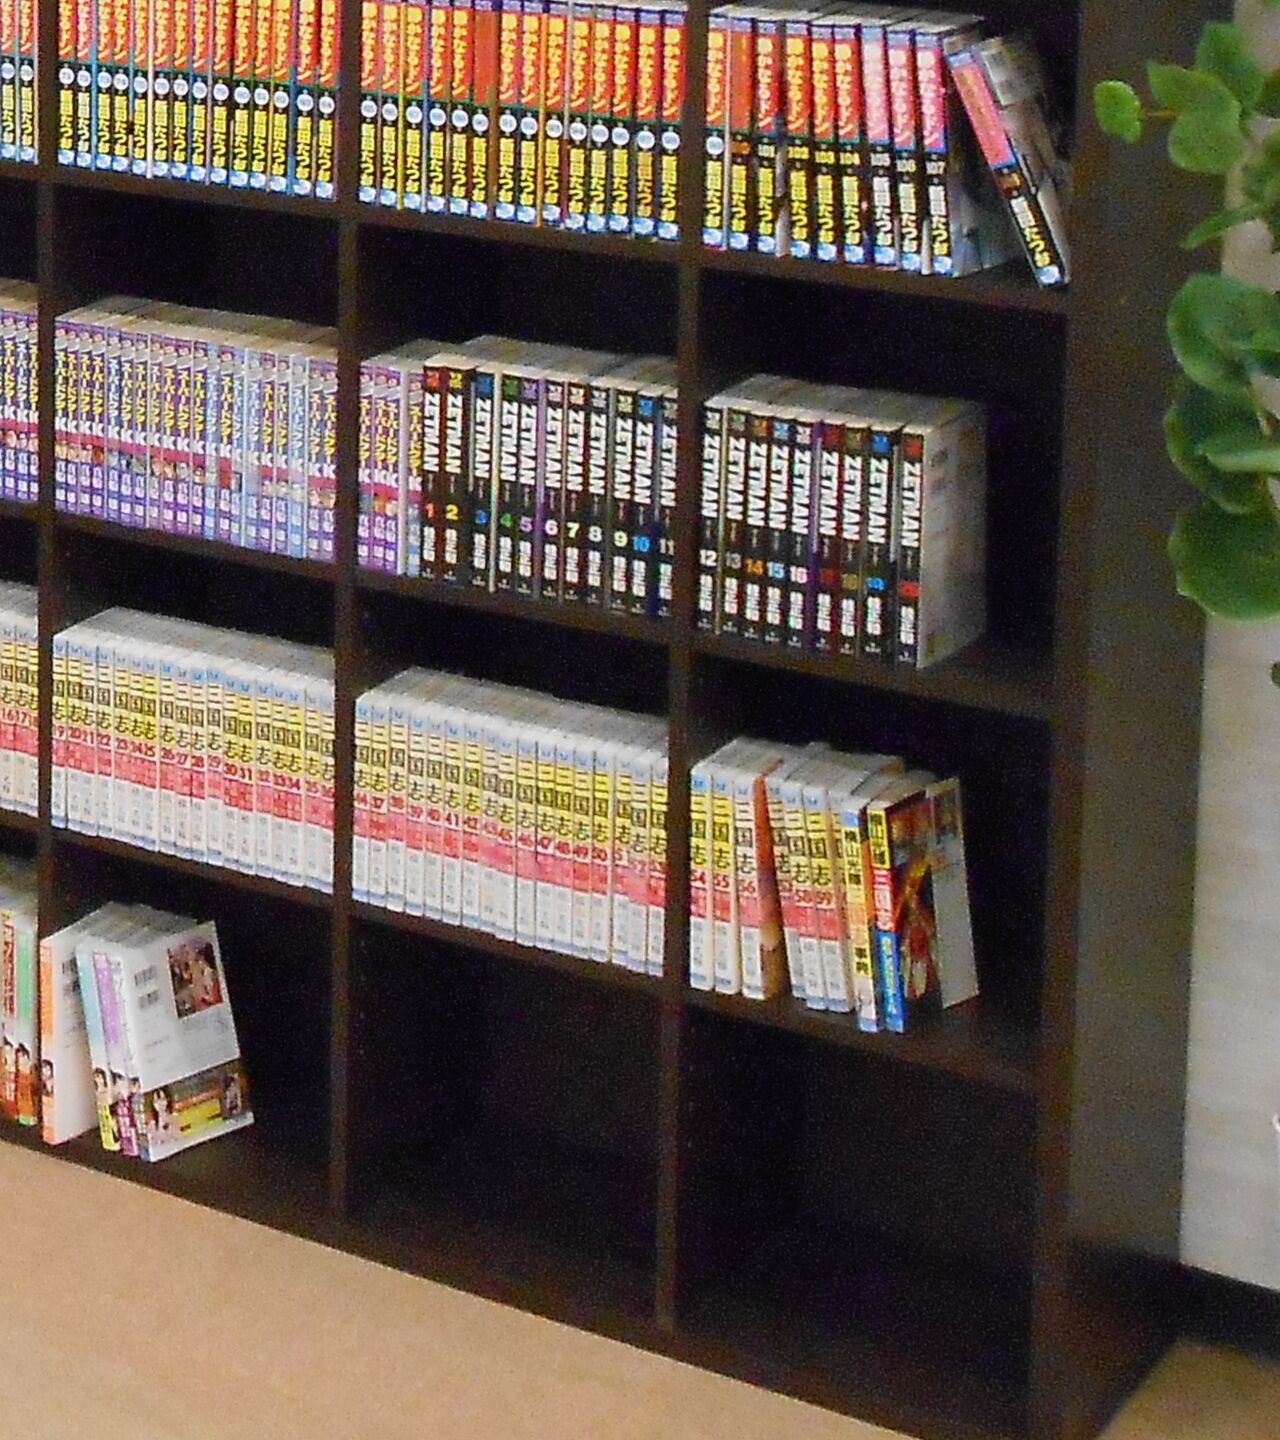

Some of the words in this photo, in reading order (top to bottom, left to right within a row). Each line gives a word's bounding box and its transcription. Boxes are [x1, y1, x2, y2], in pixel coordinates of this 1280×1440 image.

[423, 392, 440, 472] ZETMAN
[445, 394, 462, 474] ZETMAN
[475, 399, 491, 478] ZETMAN
[501, 401, 518, 481] ZETMAN
[520, 405, 537, 485] ZETMAN
[545, 408, 563, 489] ZETMAN
[567, 410, 584, 491] ZETMAN
[589, 414, 606, 495] ZETMAN
[614, 418, 632, 500] ZETMAN
[634, 421, 653, 505] ZETMAN
[661, 425, 677, 507] ZETMAN
[701, 433, 720, 518] ZETMAN
[727, 436, 745, 520] ZETMAN
[747, 441, 767, 526] ZETMAN
[769, 444, 789, 530] ZETMAN
[792, 449, 811, 535] ZETMAN
[819, 450, 839, 536] ZETMAN
[843, 454, 862, 541] ZETMAN
[868, 457, 888, 544] ZETMAN
[901, 461, 921, 548] ZETMAN
[426, 504, 435, 518] 1
[446, 505, 458, 520] 2
[475, 511, 488, 524] 3
[500, 513, 512, 527] 4
[520, 517, 533, 532] 5
[545, 520, 558, 535] 6
[567, 522, 579, 538] 7
[589, 526, 602, 542] 8
[614, 531, 627, 547] 9
[633, 536, 650, 552] 10
[659, 539, 674, 555] 11
[700, 549, 717, 567] 12
[726, 552, 741, 569] 13
[745, 559, 763, 575] 14
[767, 562, 784, 579] 15
[790, 566, 808, 583] 16
[98, 733, 111, 746] 22
[192, 755, 205, 767] 28
[224, 761, 237, 775] 30
[240, 767, 252, 781] 31
[445, 812, 460, 826] 41
[538, 837, 552, 850] 47
[592, 848, 607, 861] 50
[691, 871, 706, 884] 54
[714, 875, 729, 889] 55
[740, 879, 756, 893] 56
[817, 892, 832, 905] 59
